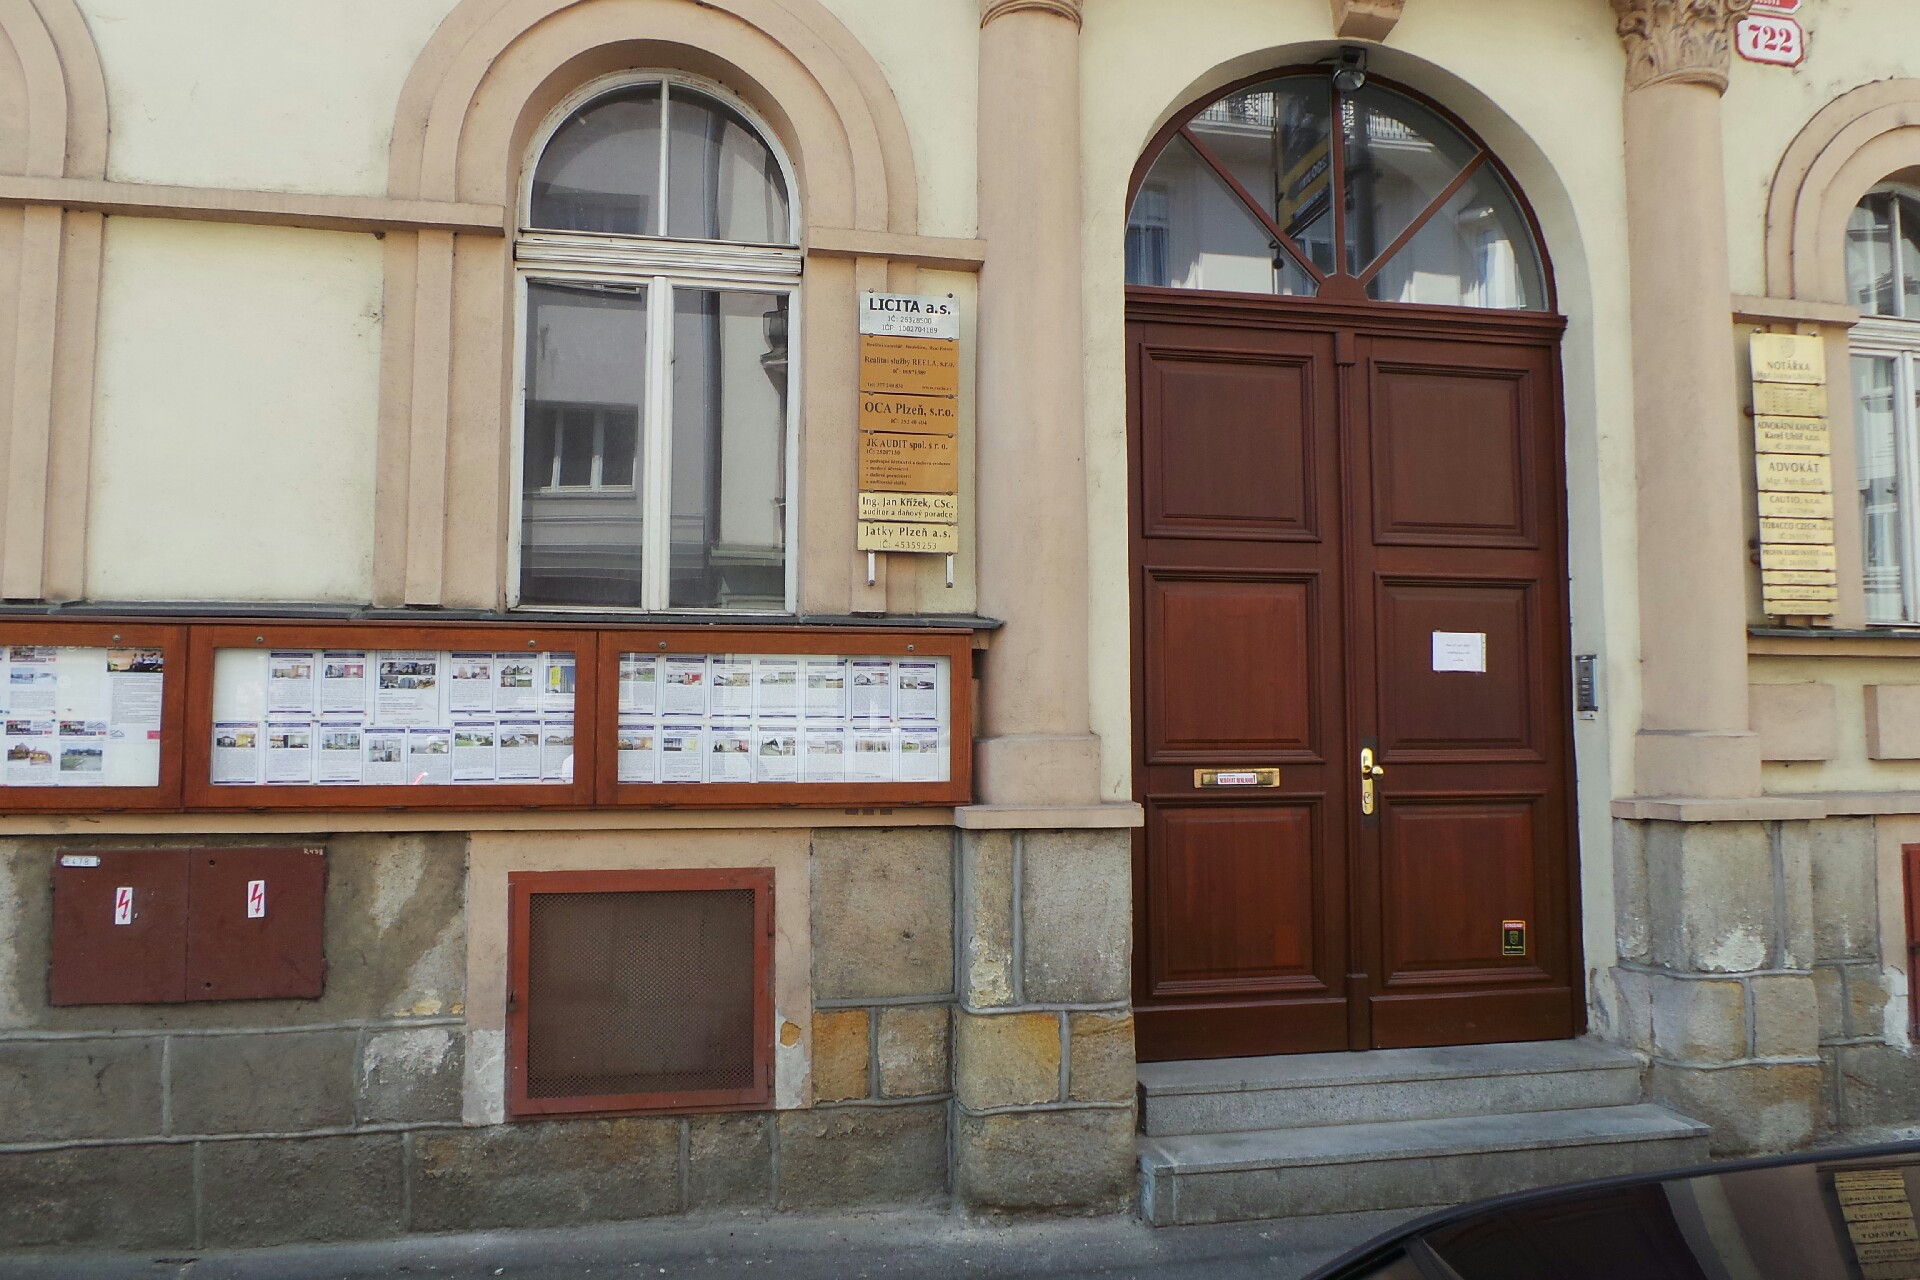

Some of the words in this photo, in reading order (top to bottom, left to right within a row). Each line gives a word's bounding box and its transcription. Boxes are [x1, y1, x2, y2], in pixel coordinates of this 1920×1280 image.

[1749, 24, 1793, 53] 722
[869, 298, 920, 313] LICITA
[926, 303, 950, 314] a.s.
[890, 357, 910, 367] služby
[1767, 360, 1810, 370] NOTÁŘKA
[865, 402, 891, 413] OCA
[896, 403, 927, 417] Plzeň,
[930, 407, 953, 417] s.r.o.
[1765, 432, 1783, 440] Karel
[866, 439, 877, 447] JK
[880, 440, 907, 448] AUDIT
[910, 441, 926, 450] spol.
[1769, 460, 1819, 472] ADVOKÁT
[862, 497, 879, 507] Ing.
[883, 497, 896, 507] Jan
[900, 498, 931, 509] Křížek,
[934, 499, 953, 508] CSc.
[898, 509, 922, 518] daňový
[925, 510, 953, 518] poradce
[865, 526, 893, 537] Jatky
[899, 527, 928, 537] Plzeň
[932, 530, 951, 538] a.s.
